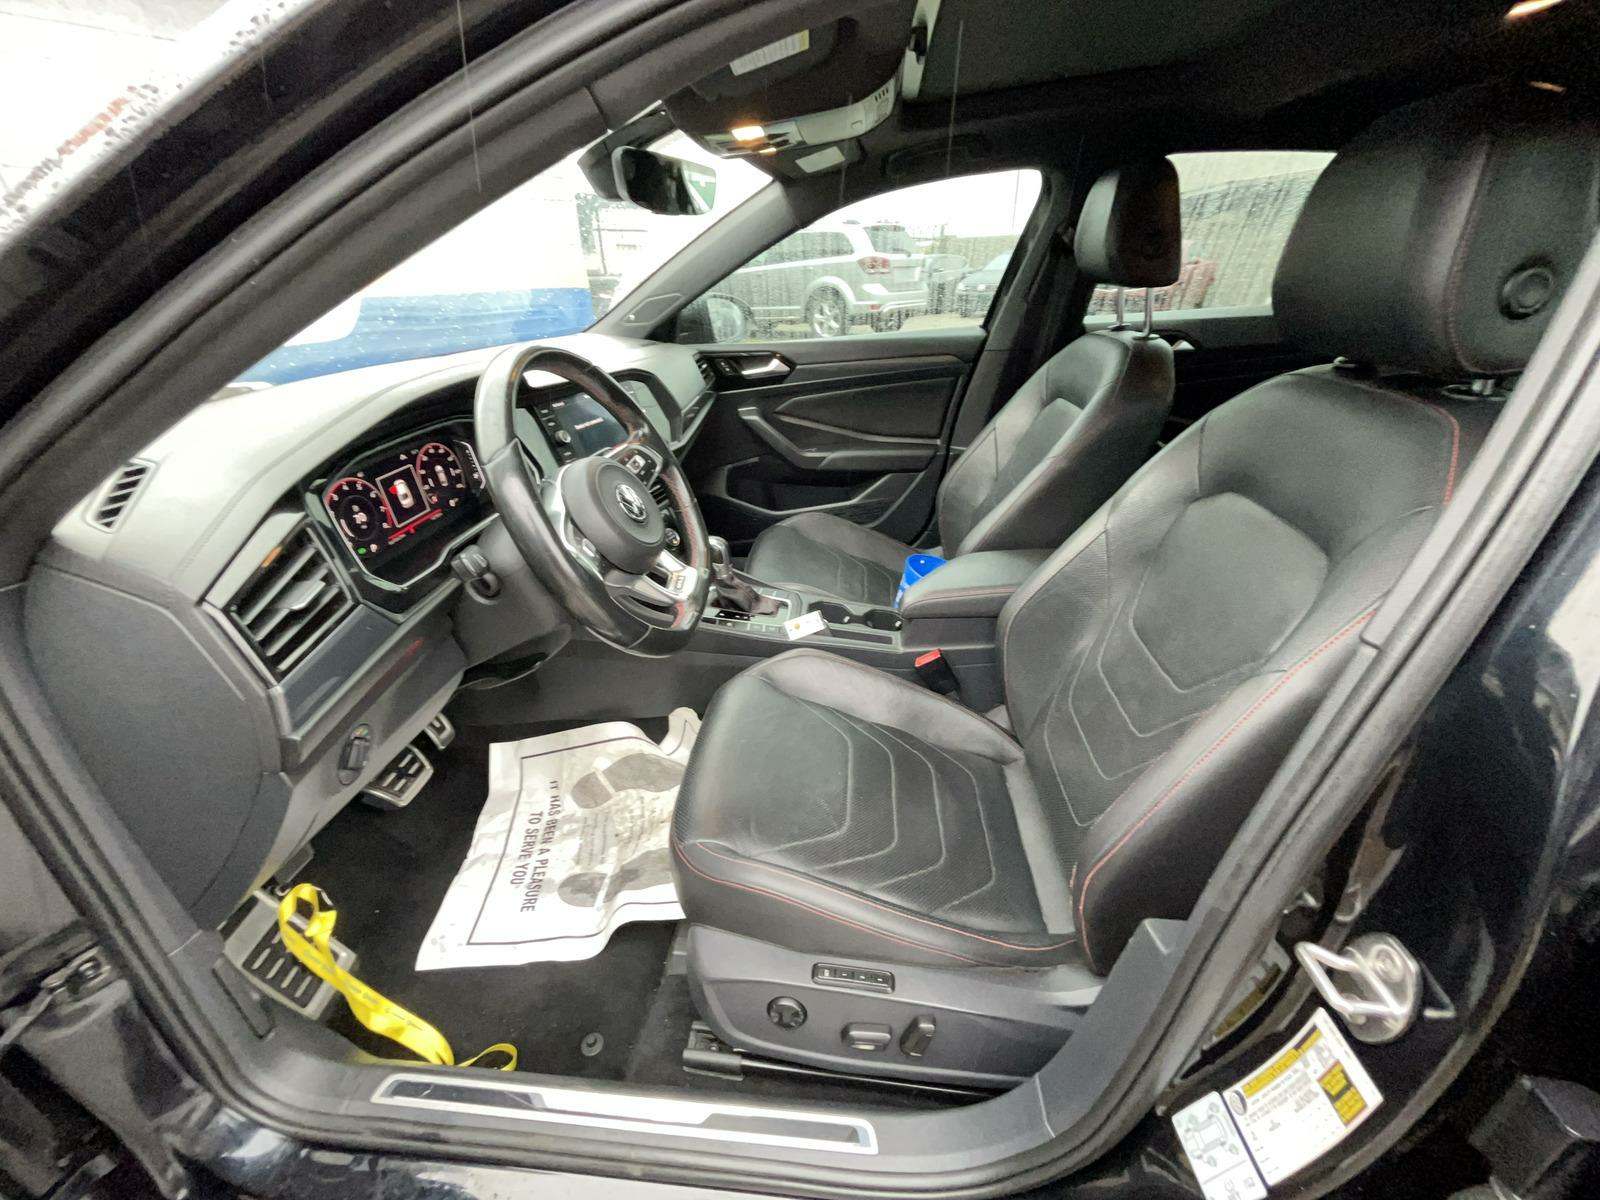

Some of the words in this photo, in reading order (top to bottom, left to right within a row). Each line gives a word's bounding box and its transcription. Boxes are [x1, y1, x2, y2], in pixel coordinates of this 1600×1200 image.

[547, 795, 561, 816] HAS
[528, 811, 543, 825] TO
[540, 818, 558, 845] BEEN
[518, 828, 540, 860] SERVE
[537, 848, 551, 856] A
[510, 862, 531, 885] YOU
[520, 858, 549, 912] PLEASURE
